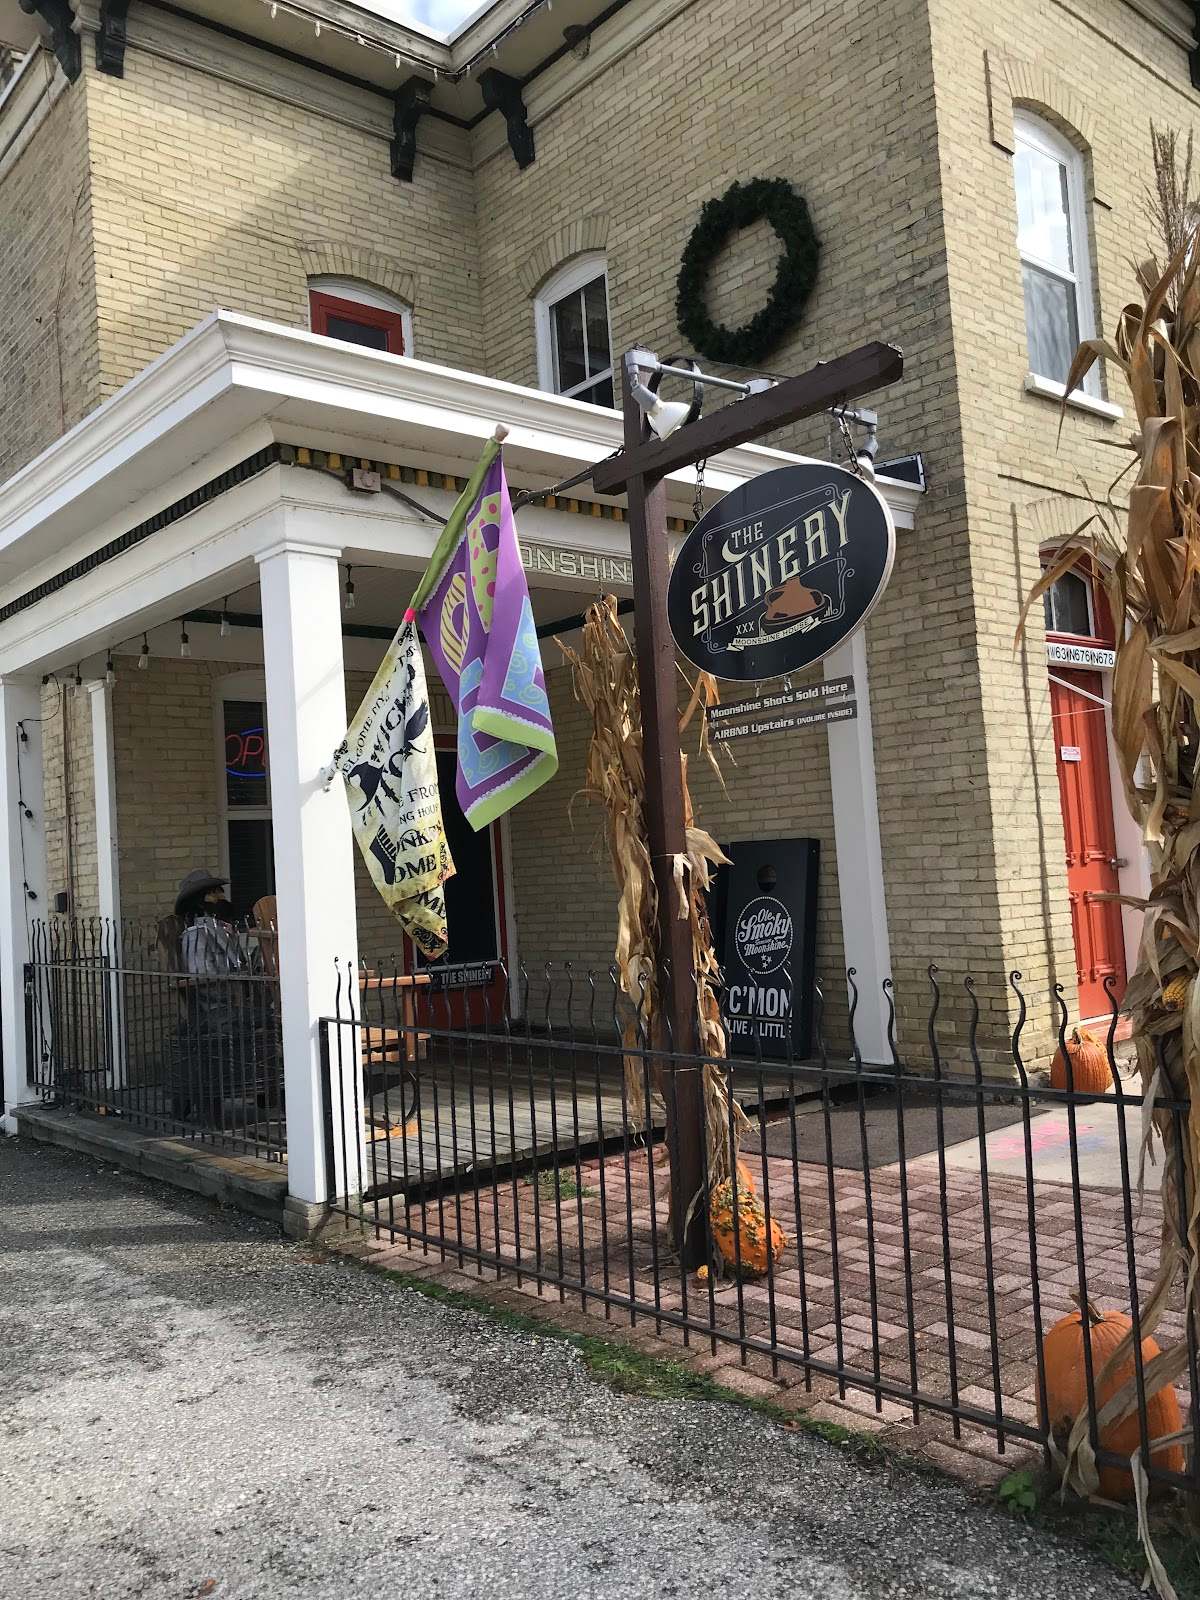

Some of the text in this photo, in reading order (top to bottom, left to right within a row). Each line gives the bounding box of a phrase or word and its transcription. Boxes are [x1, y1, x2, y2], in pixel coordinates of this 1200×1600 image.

[731, 521, 764, 549] THE
[520, 545, 633, 582] ONSHIN
[691, 488, 852, 637] SHINERY
[735, 620, 812, 646] MOONSHINE HOUSE
[736, 621, 755, 635] XXX
[710, 682, 848, 719] Moonshine Shots Sold Here
[713, 725, 749, 740] AIRBNB
[751, 718, 794, 735] Upstairs
[827, 707, 853, 719] INSIDE)
[225, 734, 268, 767] OP
[737, 912, 792, 943] Smoky
[758, 908, 775, 923] Ole
[744, 940, 789, 957] Moonshine
[729, 985, 793, 1018] C'MON
